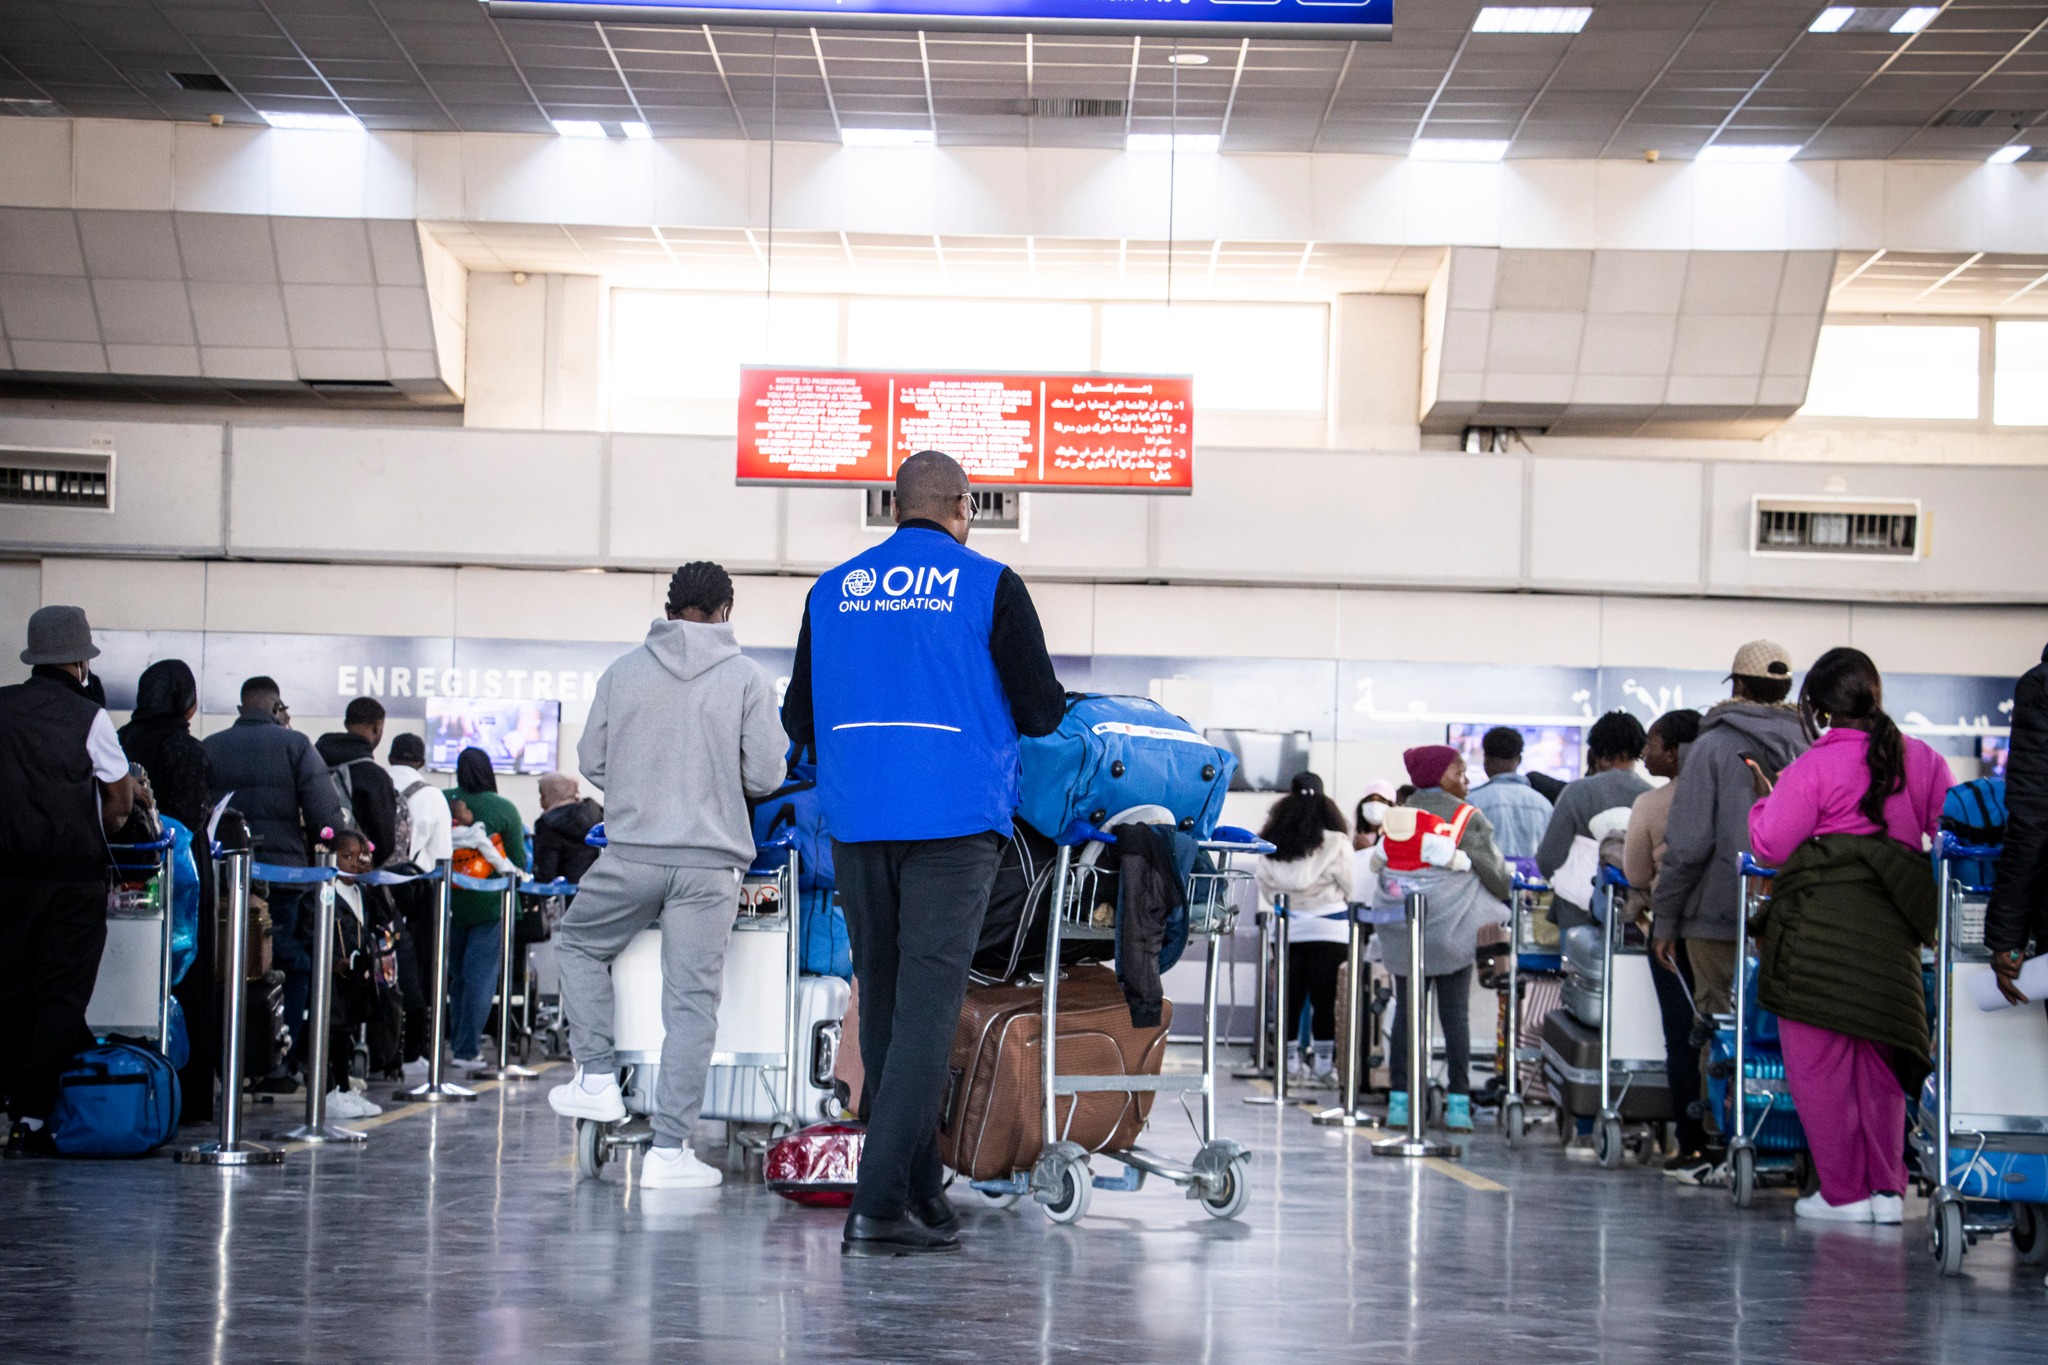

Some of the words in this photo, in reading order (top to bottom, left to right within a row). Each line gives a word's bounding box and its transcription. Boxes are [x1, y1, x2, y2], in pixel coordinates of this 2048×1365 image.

[882, 566, 960, 597] OIM
[839, 599, 871, 613] ONU
[874, 597, 953, 612] MIGRATION
